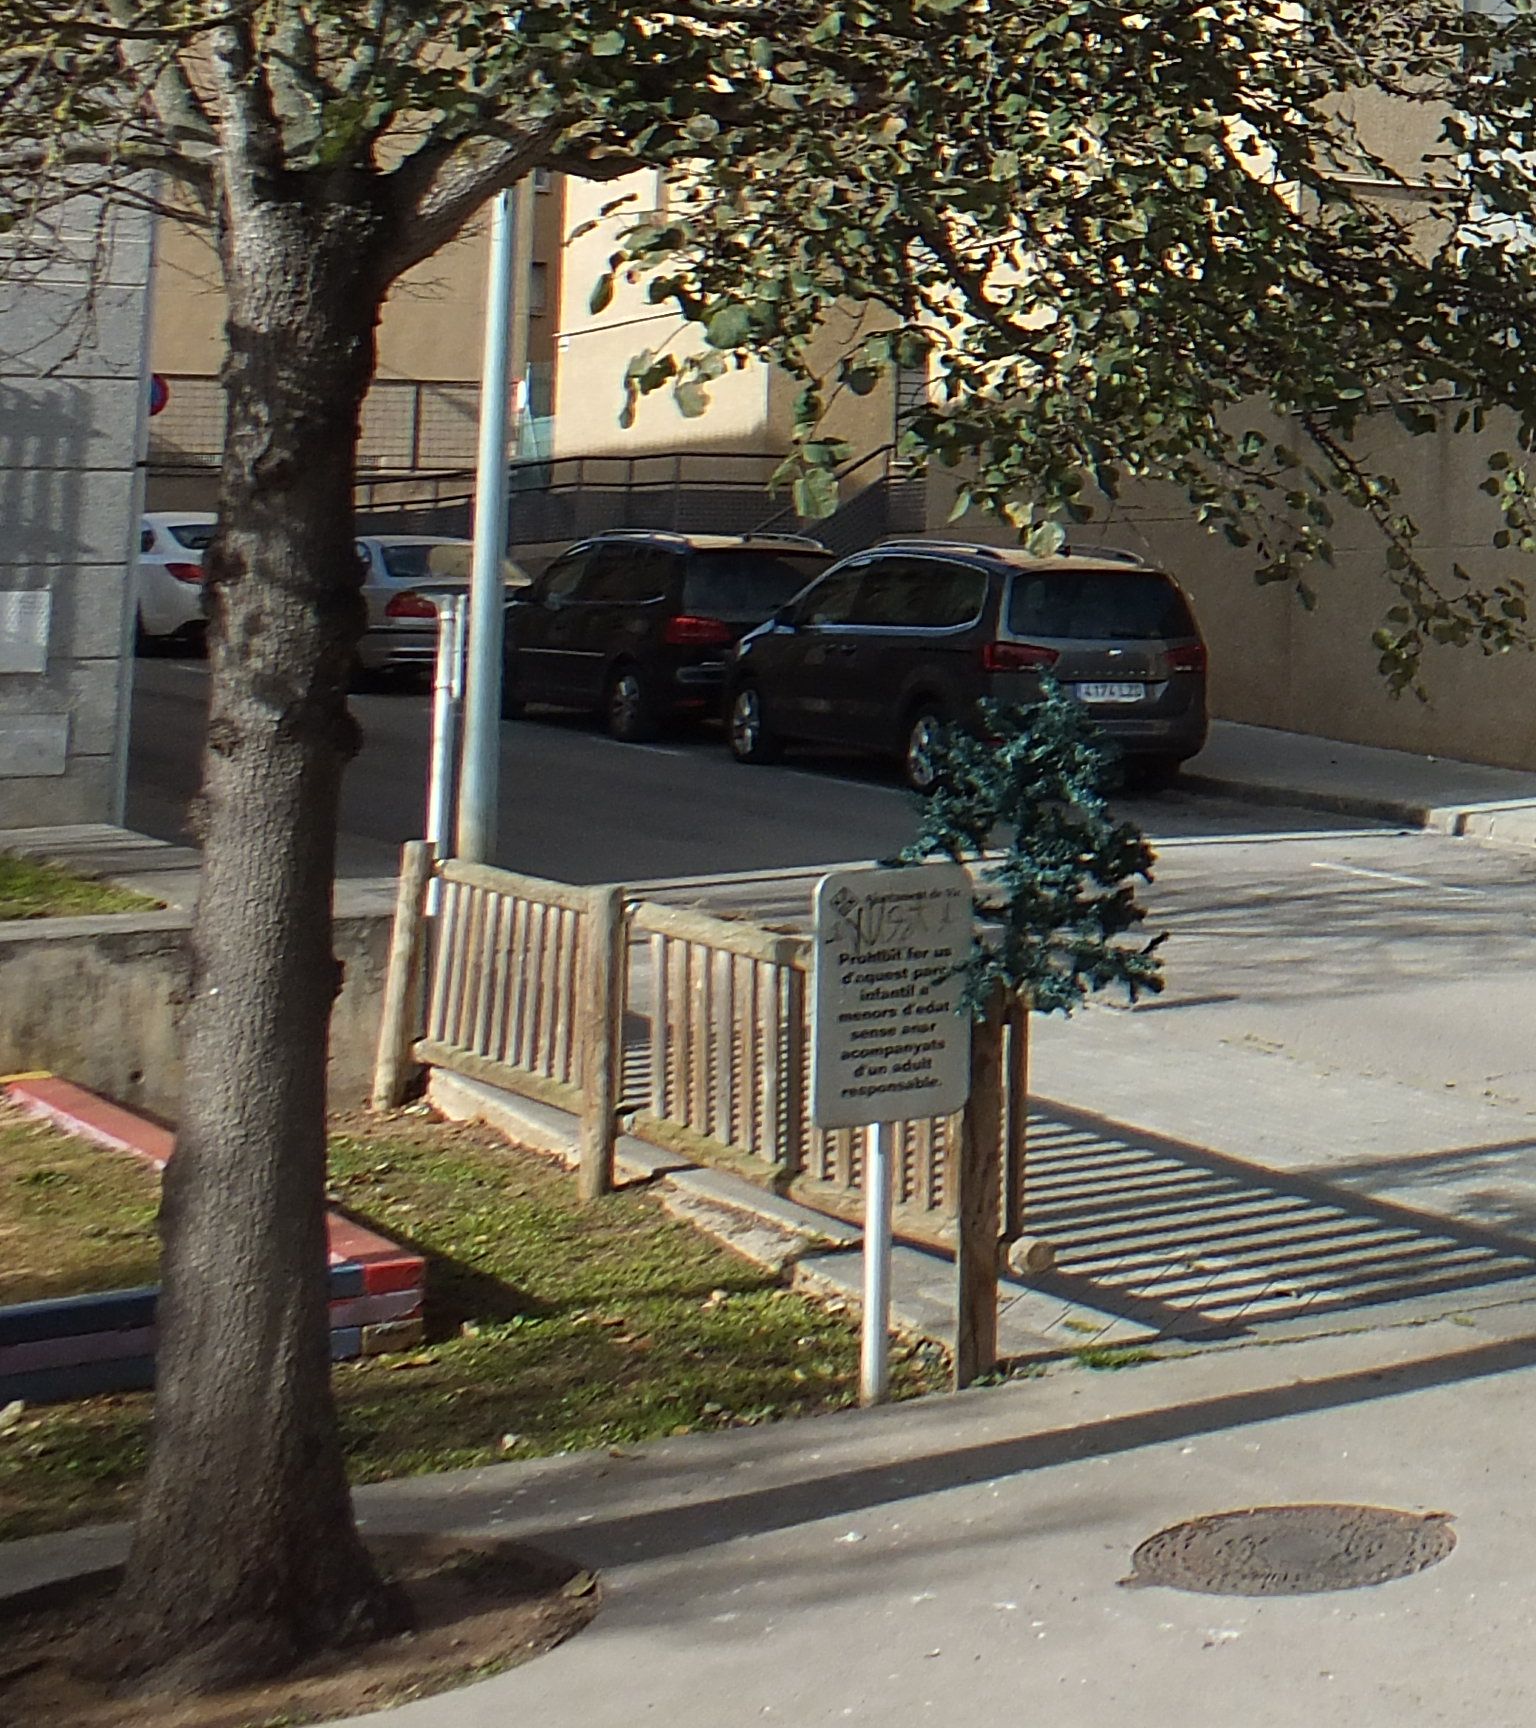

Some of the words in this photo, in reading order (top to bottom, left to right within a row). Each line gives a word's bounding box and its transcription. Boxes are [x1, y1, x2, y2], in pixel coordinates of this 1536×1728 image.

[838, 949, 902, 965] Prohibit
[907, 947, 929, 960] fer
[841, 968, 908, 985] d'aquest
[860, 984, 915, 1001] infantil
[838, 1008, 898, 1022] menors
[902, 1001, 950, 1015] d'edat
[850, 1027, 897, 1040] sense
[841, 1040, 946, 1060] acompanyats
[854, 1064, 887, 1078] d'un
[892, 1057, 932, 1072] adult
